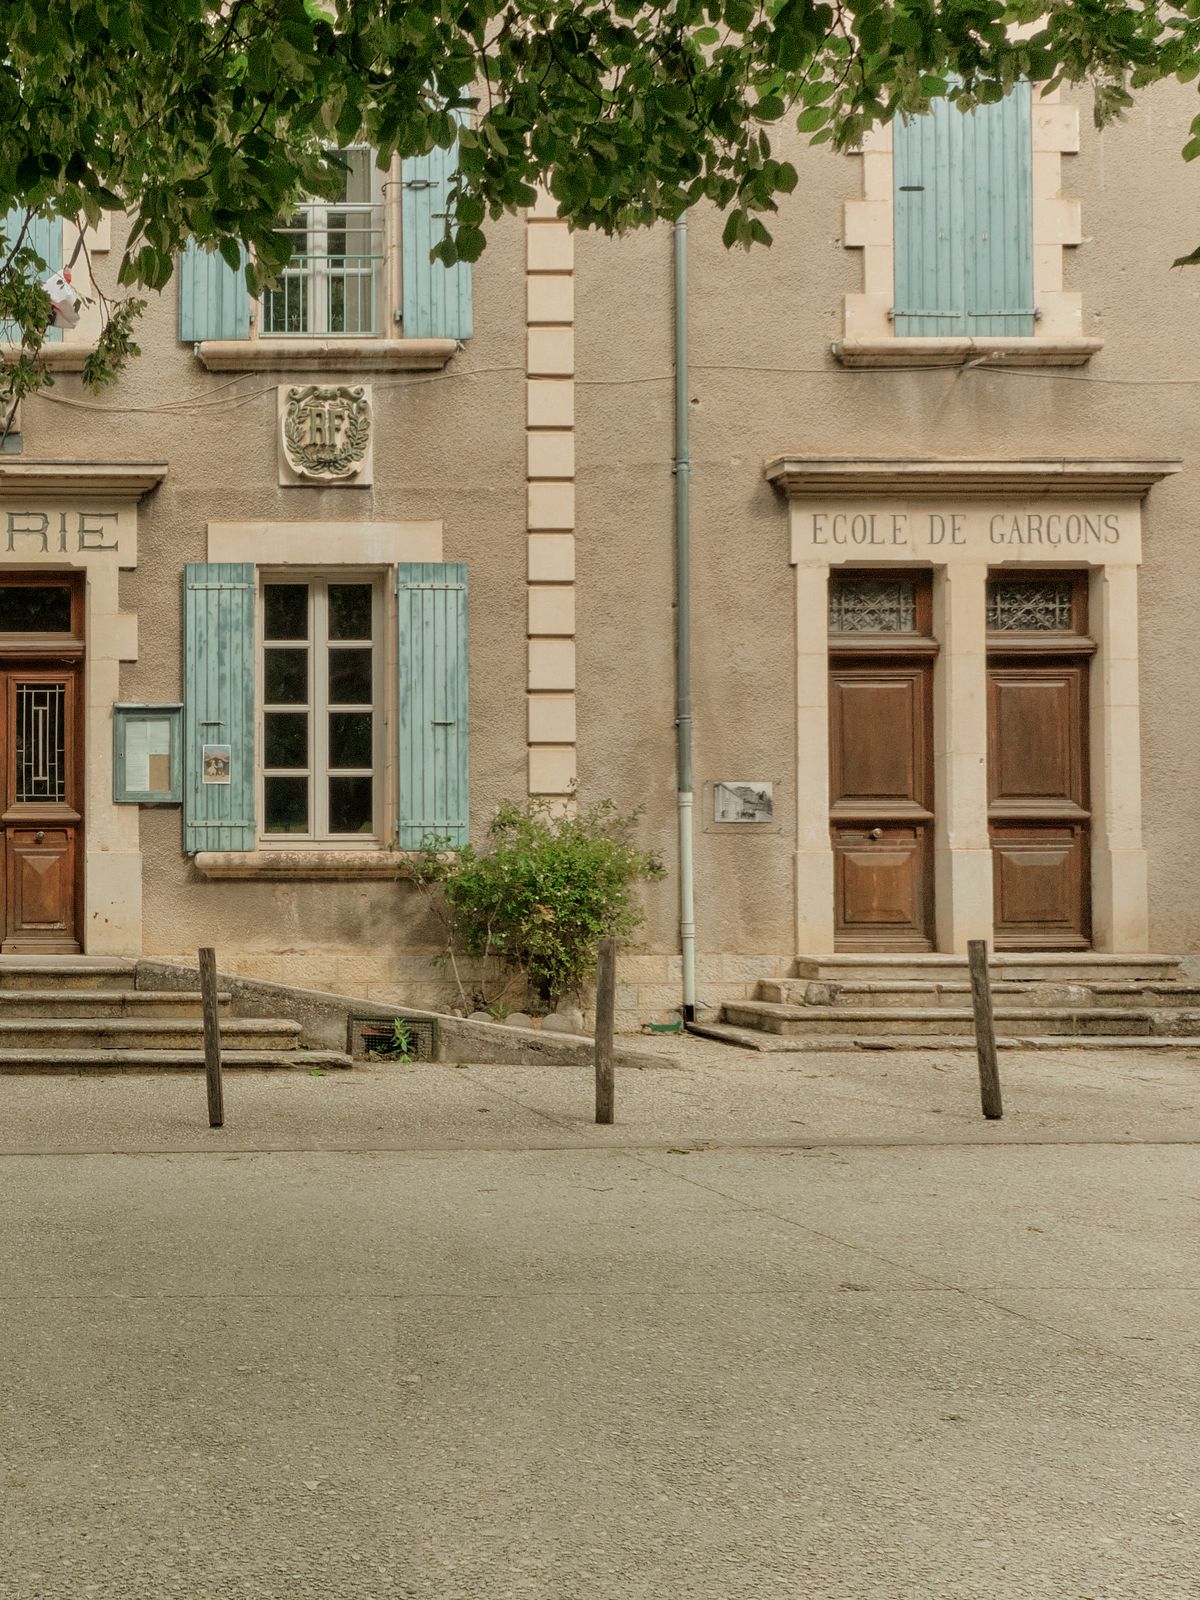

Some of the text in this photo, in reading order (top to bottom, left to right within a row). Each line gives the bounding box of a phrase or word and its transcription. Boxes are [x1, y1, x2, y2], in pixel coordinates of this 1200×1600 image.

[309, 409, 345, 446] RF
[811, 513, 1121, 548] ECOLE DE GARÇONS
